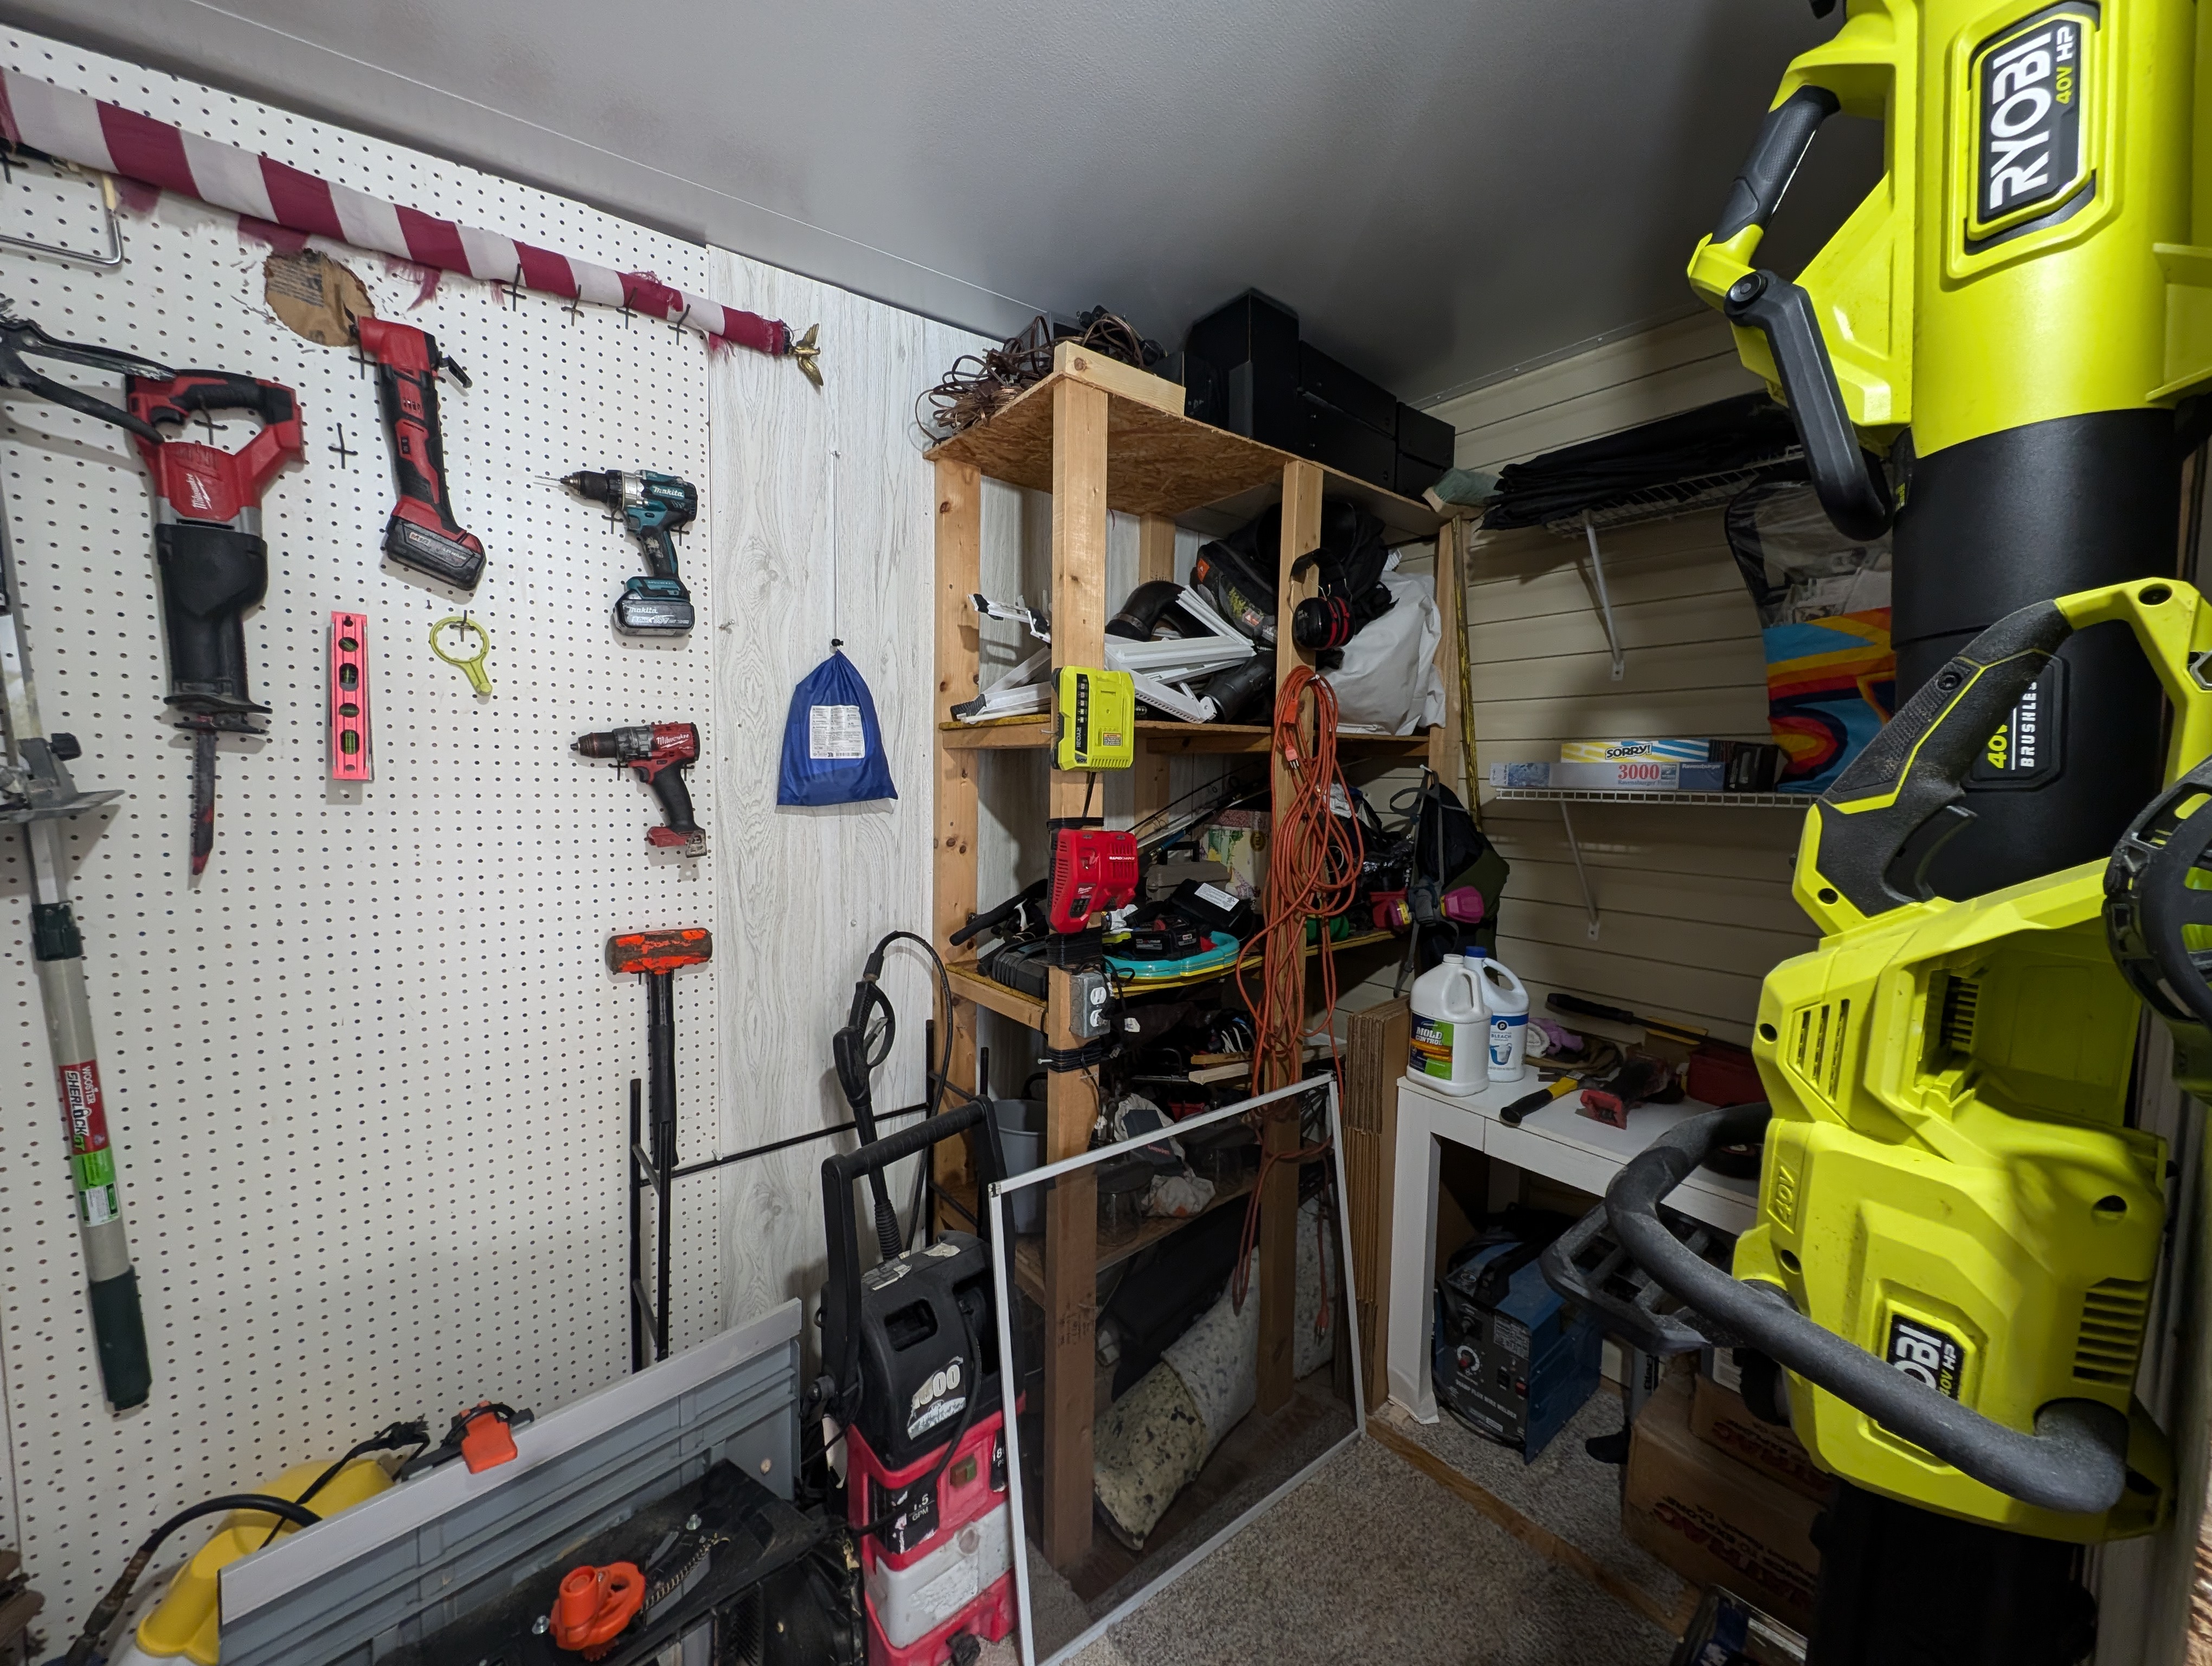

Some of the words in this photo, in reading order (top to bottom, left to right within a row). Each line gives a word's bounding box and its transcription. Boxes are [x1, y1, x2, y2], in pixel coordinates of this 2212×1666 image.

[2056, 27, 2076, 62] HP
[2056, 67, 2074, 105] 40V
[1990, 33, 2052, 210] RYOBI
[2020, 682, 2037, 767] BRUSHLES
[1606, 745, 1650, 758] SORRY!
[1618, 764, 1660, 779] 3000
[1416, 1027, 1443, 1040] MOLD
[1416, 1035, 1443, 1046] CONTROL
[82, 1066, 97, 1104] WOOSTER
[65, 1071, 92, 1136] SHERLOCK
[1776, 1166, 1795, 1222] 40V
[1894, 1324, 1944, 1389] OBI
[1944, 1344, 1956, 1371] HP
[993, 1447, 1005, 1462] 18
[912, 1507, 929, 1521] GPM
